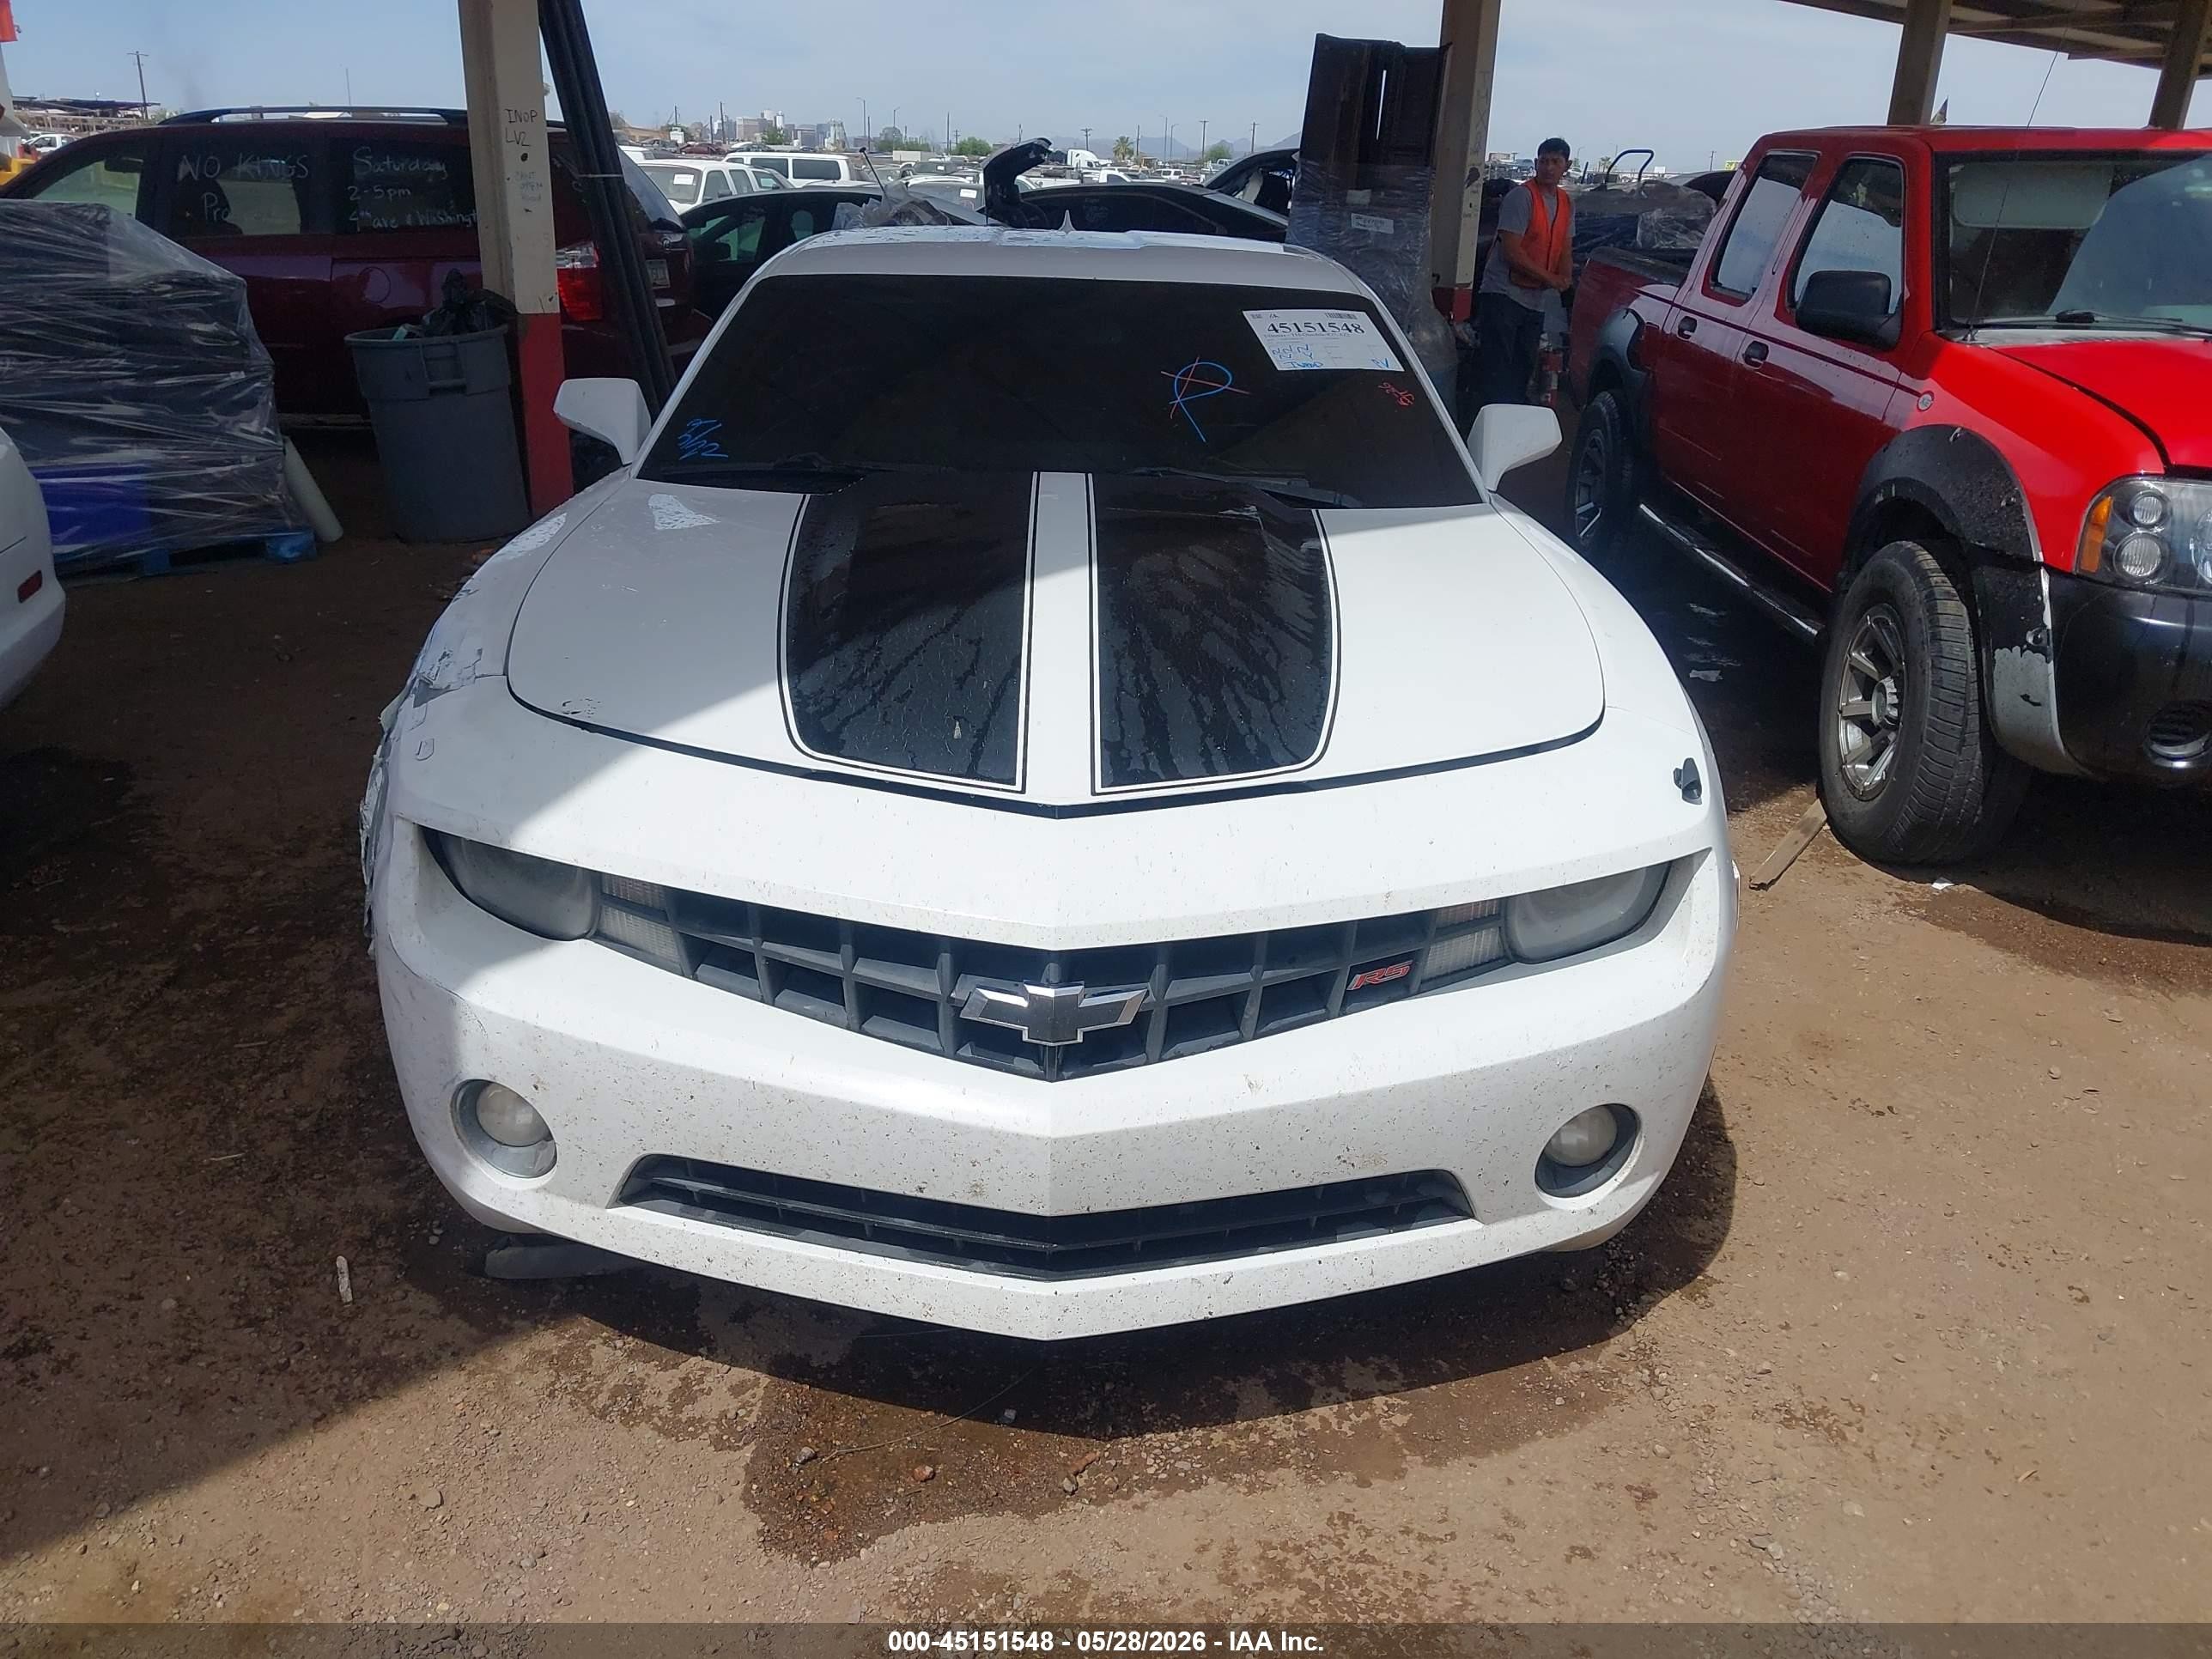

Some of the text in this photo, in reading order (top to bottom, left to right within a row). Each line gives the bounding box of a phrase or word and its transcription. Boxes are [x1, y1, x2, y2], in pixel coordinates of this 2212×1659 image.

[505, 109, 537, 123] INOP
[177, 153, 308, 181] NO KINGS
[353, 146, 448, 179] Saturday
[372, 216, 399, 228] ave
[1267, 322, 1365, 334] 45151548
[1346, 960, 1413, 990] RS
